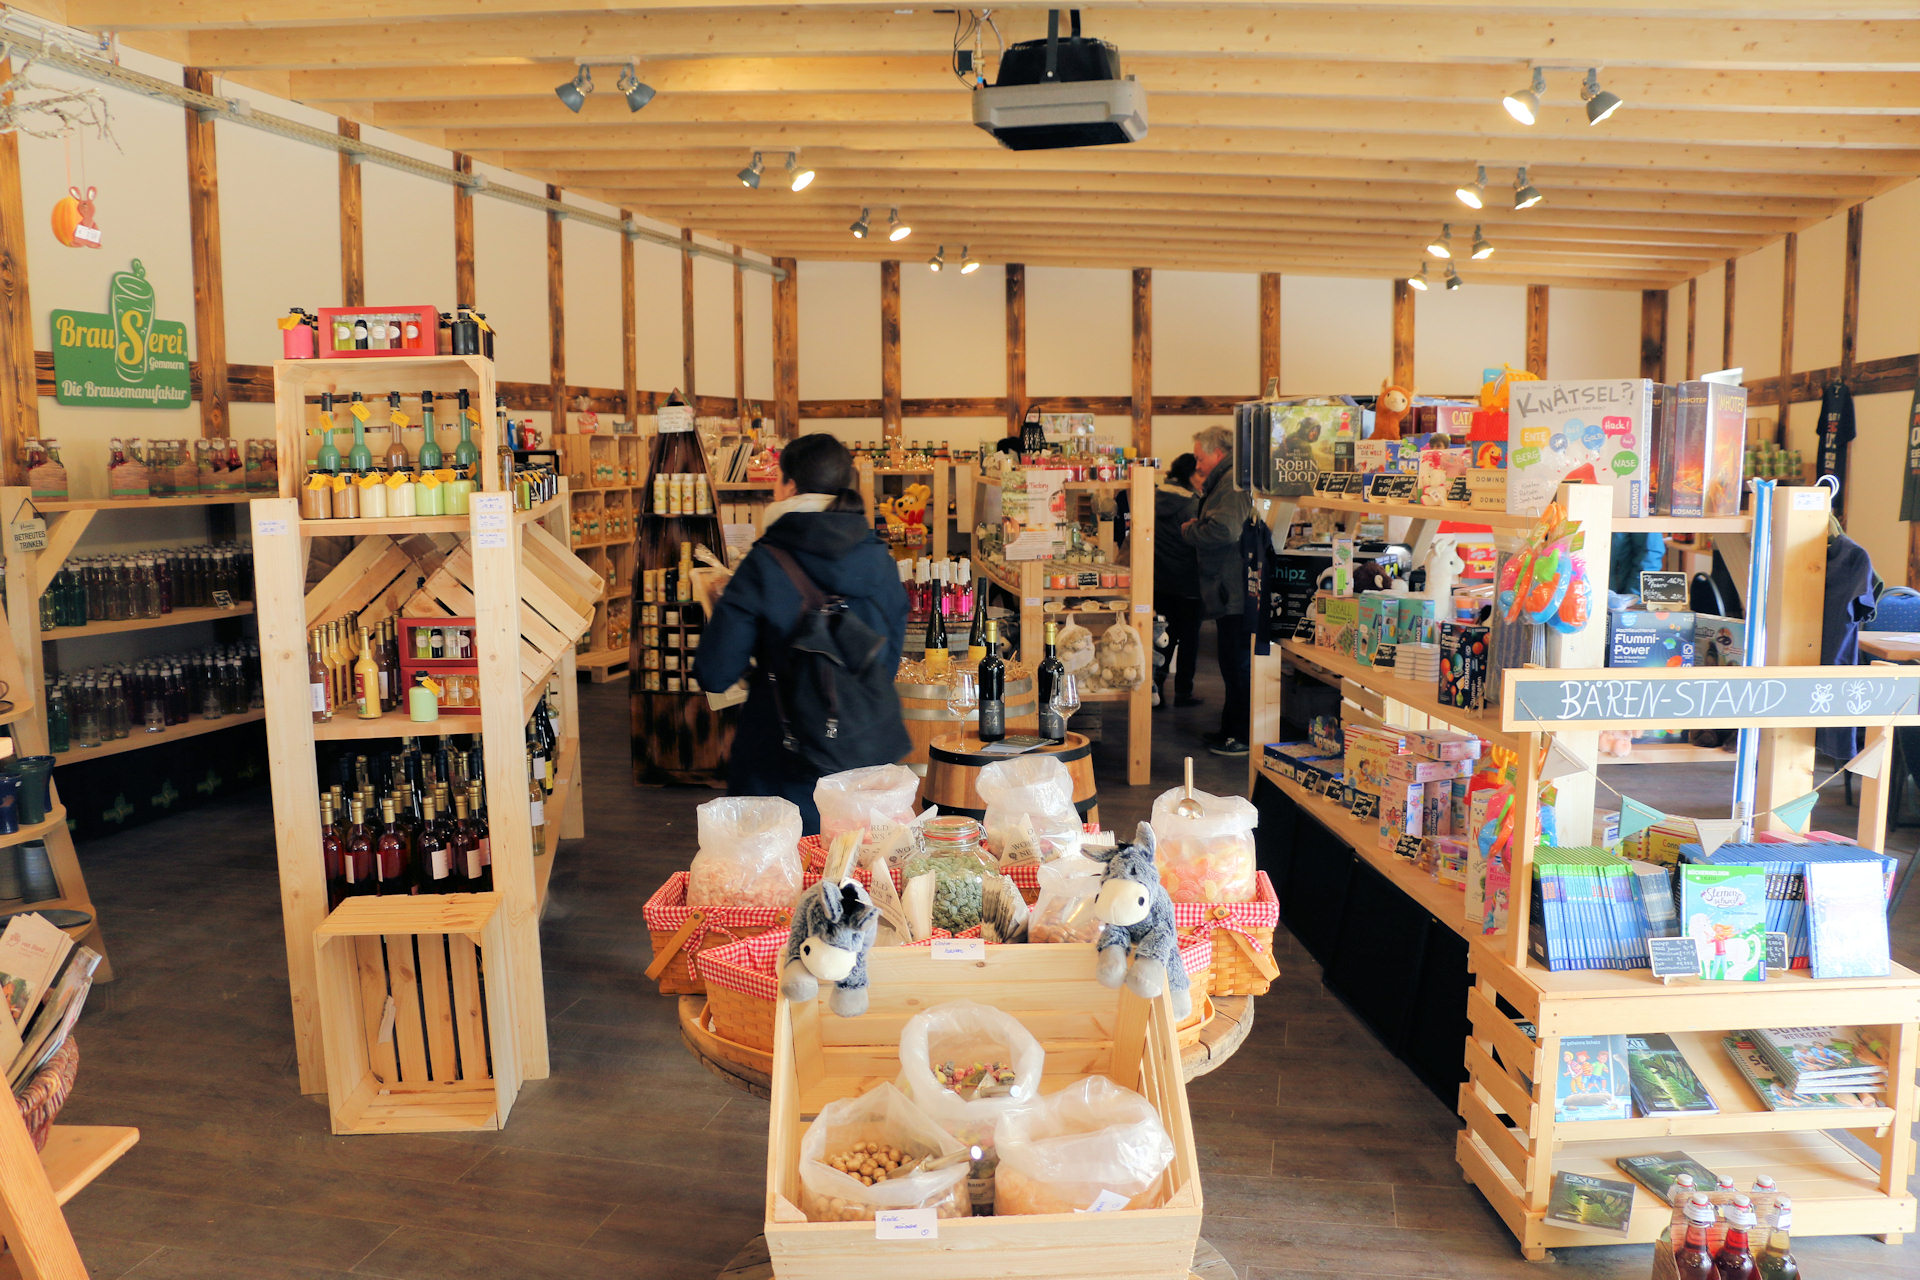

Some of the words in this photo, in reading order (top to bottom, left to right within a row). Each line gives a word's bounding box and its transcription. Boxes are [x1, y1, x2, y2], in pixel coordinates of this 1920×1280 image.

[149, 357, 185, 371] Gommern
[61, 380, 83, 398] Die
[84, 381, 187, 404] Brausemanufaktur
[1604, 420, 1631, 430] Hack!
[1523, 431, 1547, 443] ENTE
[1515, 450, 1540, 463] BERG
[1274, 457, 1319, 471] ROBIN
[1613, 460, 1637, 468] NASE
[1278, 470, 1317, 483] HOOD
[1631, 482, 1640, 516] KOSMOS
[1672, 508, 1702, 516] KOSMOS
[14, 530, 46, 542] BETREUTES
[19, 540, 44, 550] TRINKEN
[1614, 634, 1660, 644] Flummi-
[1614, 645, 1651, 655] Power
[1556, 679, 1787, 719] BÄREN-STAND
[1781, 1031, 1834, 1040] WERKSTATT
[1626, 1039, 1644, 1049] XIT
[1564, 1174, 1599, 1185] EXIT
